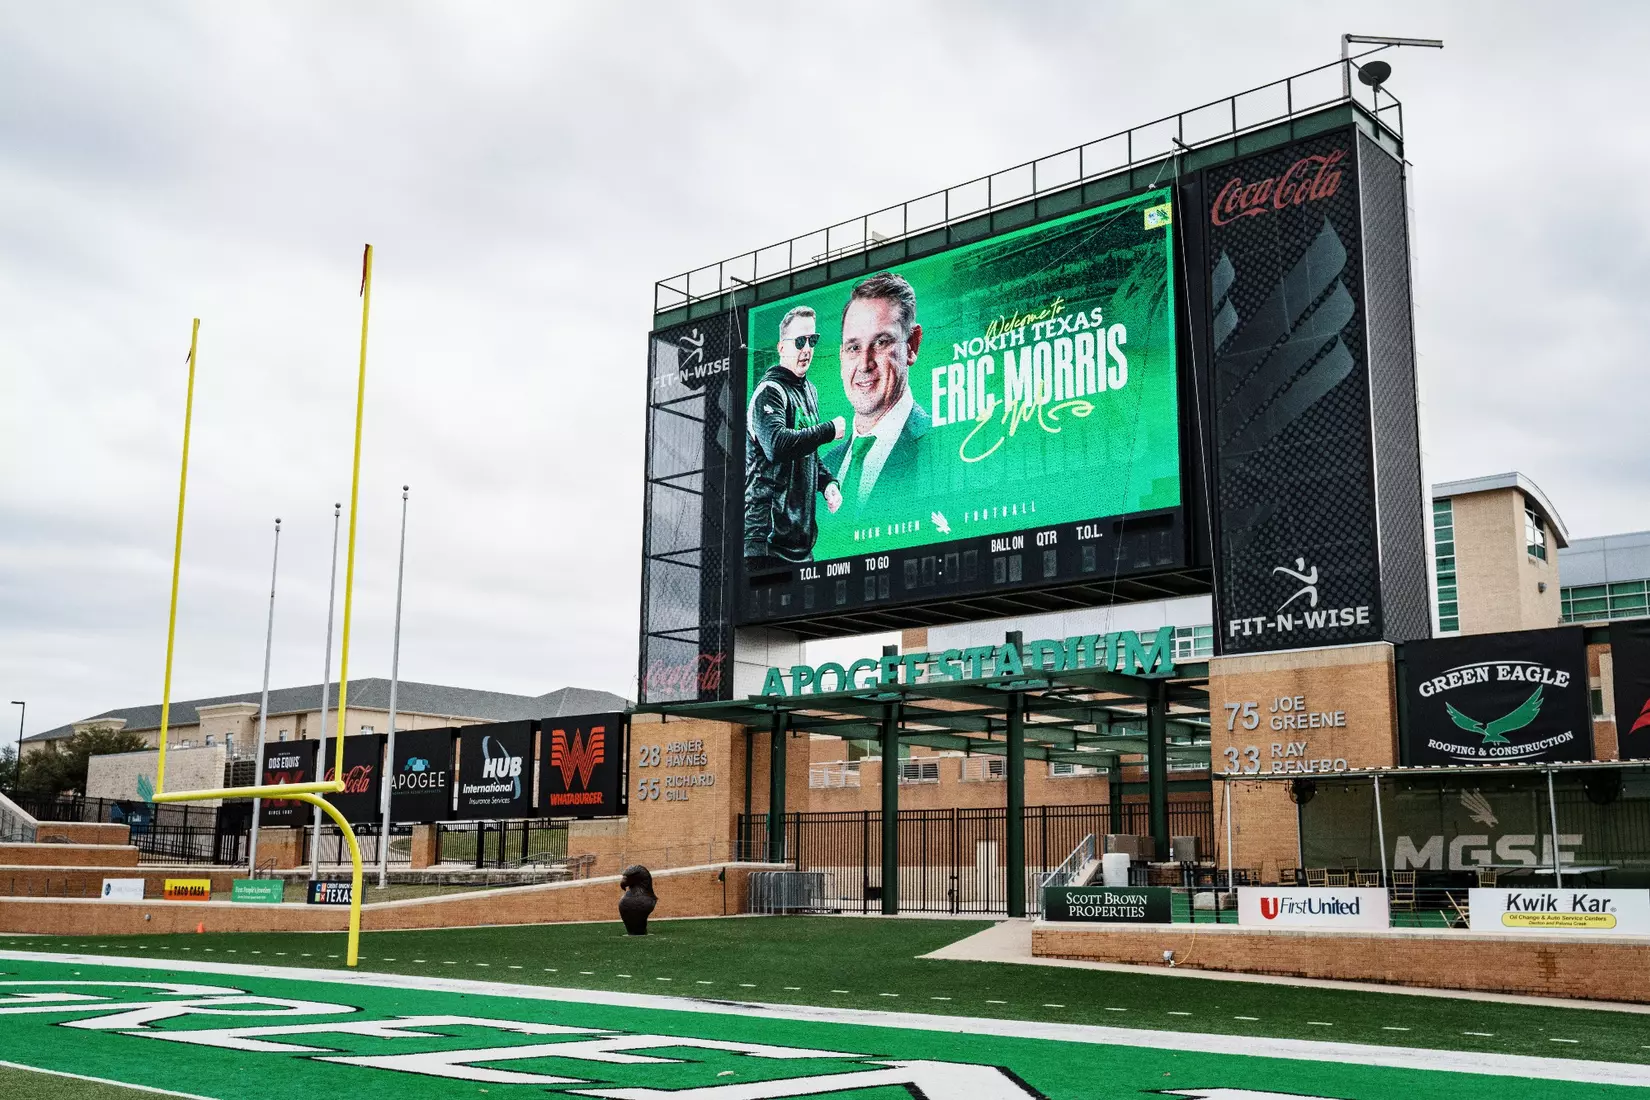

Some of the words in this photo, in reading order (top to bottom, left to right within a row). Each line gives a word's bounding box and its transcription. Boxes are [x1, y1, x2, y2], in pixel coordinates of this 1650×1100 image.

[1211, 149, 1349, 226] Coca-Cola
[984, 309, 1050, 341] Welcome
[1050, 296, 1065, 320] to
[952, 325, 1025, 361] NORTH
[1031, 307, 1103, 341] TEXAS
[653, 357, 730, 388] FIT-N-WISE
[932, 354, 995, 428] ERIC
[1003, 323, 1128, 413] MORRIS
[964, 501, 1036, 523] FOOTBALL
[1036, 530, 1058, 547] QTR
[1076, 524, 1103, 541] T.O.L.
[991, 537, 1011, 552] BALL
[1012, 535, 1024, 550] ON
[800, 567, 821, 581] T.O.L.
[826, 561, 850, 577] DOWN
[865, 557, 876, 571] TO
[877, 555, 889, 569] GO
[1229, 606, 1370, 637] FIT-N-WISE
[1418, 665, 1490, 698] GREEN
[1496, 665, 1571, 689] EAGLE
[1224, 701, 1260, 731] 75
[1270, 696, 1306, 714] JOE
[1270, 711, 1346, 731] GREENE
[639, 744, 662, 768] 28
[665, 739, 704, 754] ABNER
[1427, 738, 1476, 757] ROOFING
[1478, 747, 1486, 757] &
[1489, 730, 1575, 757] CONSTRUCTION
[268, 757, 281, 769] DOS
[281, 756, 299, 769] EQUIS
[482, 756, 522, 779] HUB
[665, 752, 708, 768] HAYNES
[1223, 745, 1261, 773] 33
[1271, 742, 1308, 758] RAY
[391, 771, 446, 790] APOGEE
[463, 780, 513, 794] International
[637, 778, 661, 801] 55
[665, 773, 715, 788] RICHARD
[469, 797, 491, 805] Insurance
[491, 796, 511, 804] Services
[550, 791, 604, 806] WHATABURGER
[665, 789, 689, 801] GILL
[1069, 905, 1145, 918] PROPERTIES
[1506, 893, 1558, 911] Kwik
[1571, 894, 1612, 913] Kar
